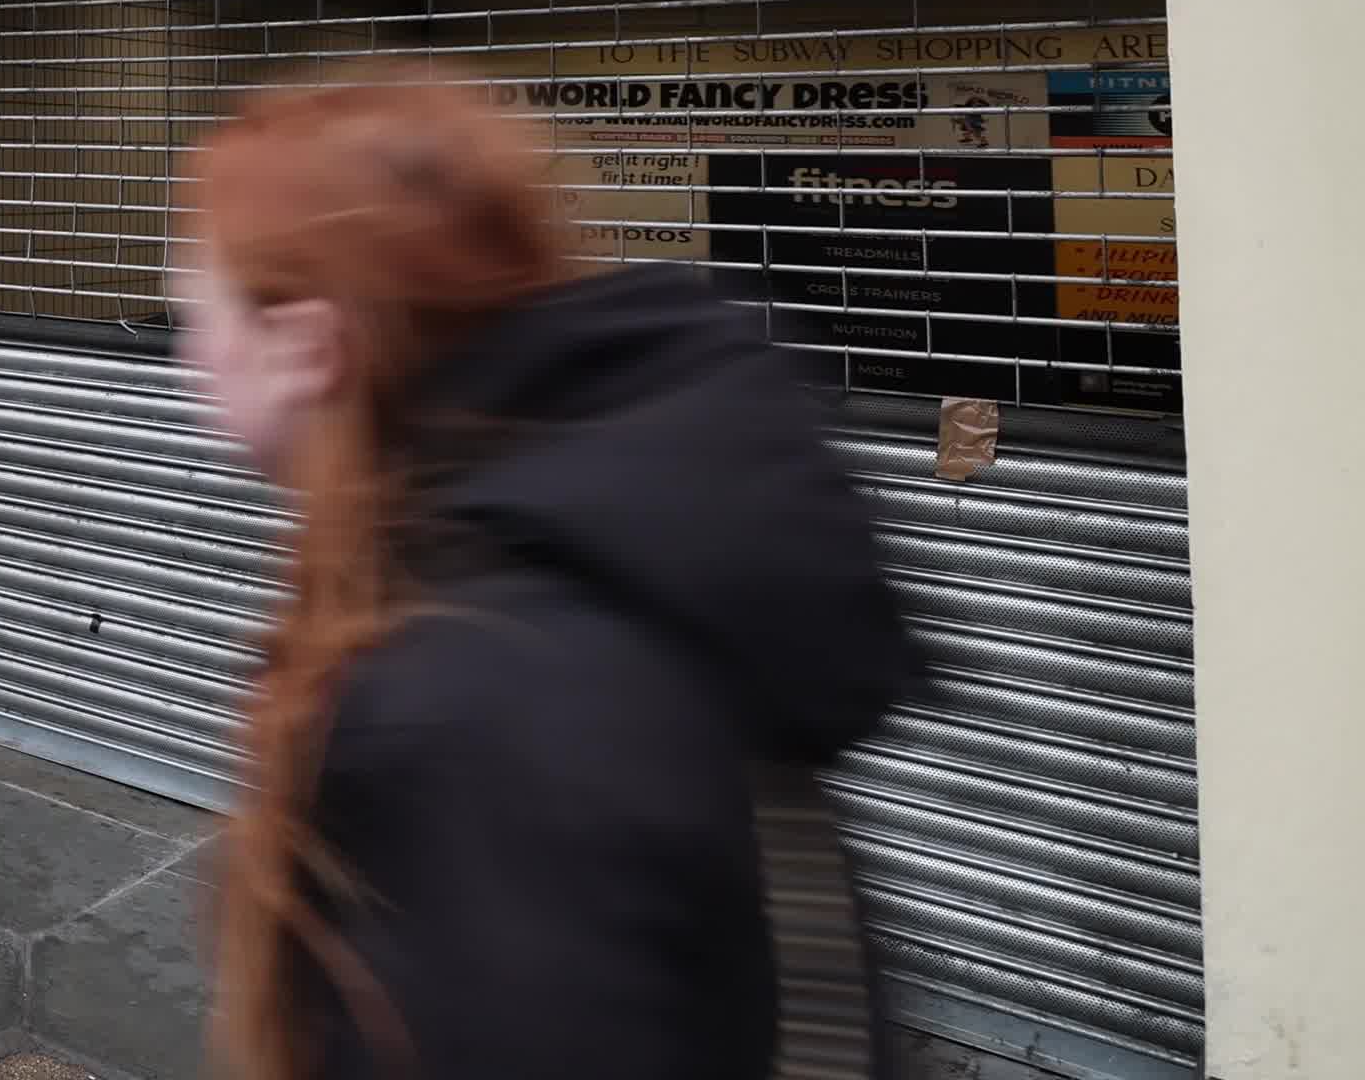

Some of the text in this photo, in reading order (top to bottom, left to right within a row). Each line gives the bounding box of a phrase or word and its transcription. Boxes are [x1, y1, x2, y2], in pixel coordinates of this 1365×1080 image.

[596, 44, 635, 64] TO
[656, 42, 710, 63] THE
[733, 39, 853, 63] SUBWAY
[876, 35, 1062, 62] SHOPPING
[525, 81, 652, 109] WORLD
[592, 155, 620, 169] get
[626, 155, 638, 167] it
[644, 155, 689, 171] right
[641, 172, 683, 185] time
[788, 168, 959, 210] fitness
[582, 227, 693, 244] photos
[825, 246, 921, 261] TREADMILLS
[864, 287, 943, 303] TRAINERS
[832, 323, 918, 340] NUTRITION
[858, 364, 905, 378] MORE
